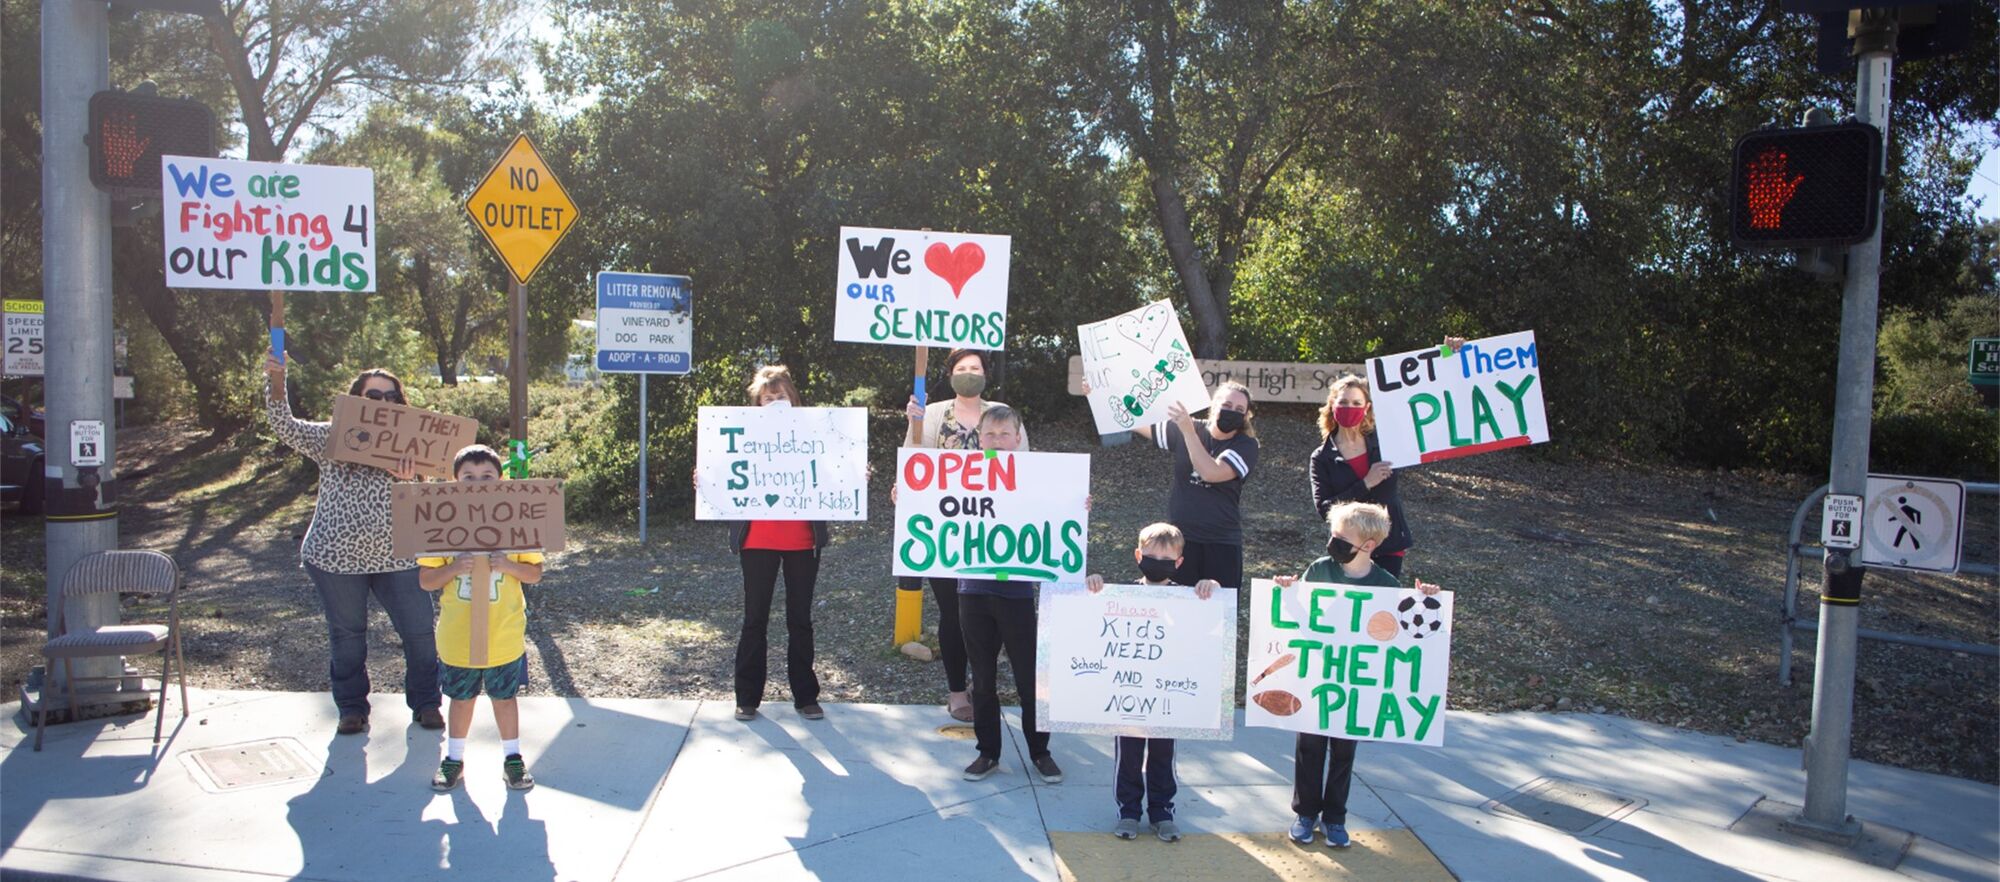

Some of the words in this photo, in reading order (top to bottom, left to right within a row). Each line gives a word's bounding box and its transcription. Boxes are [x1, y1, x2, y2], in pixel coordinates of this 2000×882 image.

[168, 163, 234, 199] We
[248, 174, 300, 198] are
[510, 166, 539, 192] NO
[180, 200, 333, 251] Fighting
[343, 204, 368, 247] 4
[484, 202, 564, 231] OUTLET
[169, 247, 248, 280] our
[261, 235, 370, 291] Kids
[846, 237, 912, 279] We
[606, 283, 638, 297] LITTER
[641, 285, 682, 299] REMOVAL
[7, 317, 44, 326] SPEED
[11, 328, 40, 336] LIMIT
[622, 317, 671, 328] VINEYARD
[869, 304, 1004, 348] SENIORS
[8, 337, 44, 354] 25
[615, 333, 638, 343] DOG
[649, 334, 675, 345] PARK
[608, 352, 636, 363] ADOPT
[658, 354, 681, 364] ROAD
[1245, 368, 1296, 396] High
[360, 405, 404, 428] LET
[419, 414, 460, 437] THEM
[1408, 374, 1536, 453] PLAY
[720, 427, 825, 462] Templeton
[727, 459, 818, 495] Strong!
[904, 452, 1017, 491] OPEN
[414, 501, 456, 524] NO
[469, 501, 547, 523] MORE
[732, 497, 761, 508] we
[783, 495, 812, 510] our
[1828, 504, 1857, 512] BUTTON
[1832, 498, 1854, 506] PUSH
[899, 513, 1083, 573] SCHOOLS
[1105, 601, 1158, 616] Please
[1271, 586, 1374, 634] LET
[1100, 617, 1166, 640] Kids
[1103, 641, 1163, 661] NEED
[1112, 670, 1143, 684] AND
[1288, 639, 1422, 693] THEM
[1311, 683, 1441, 742] PLAY
